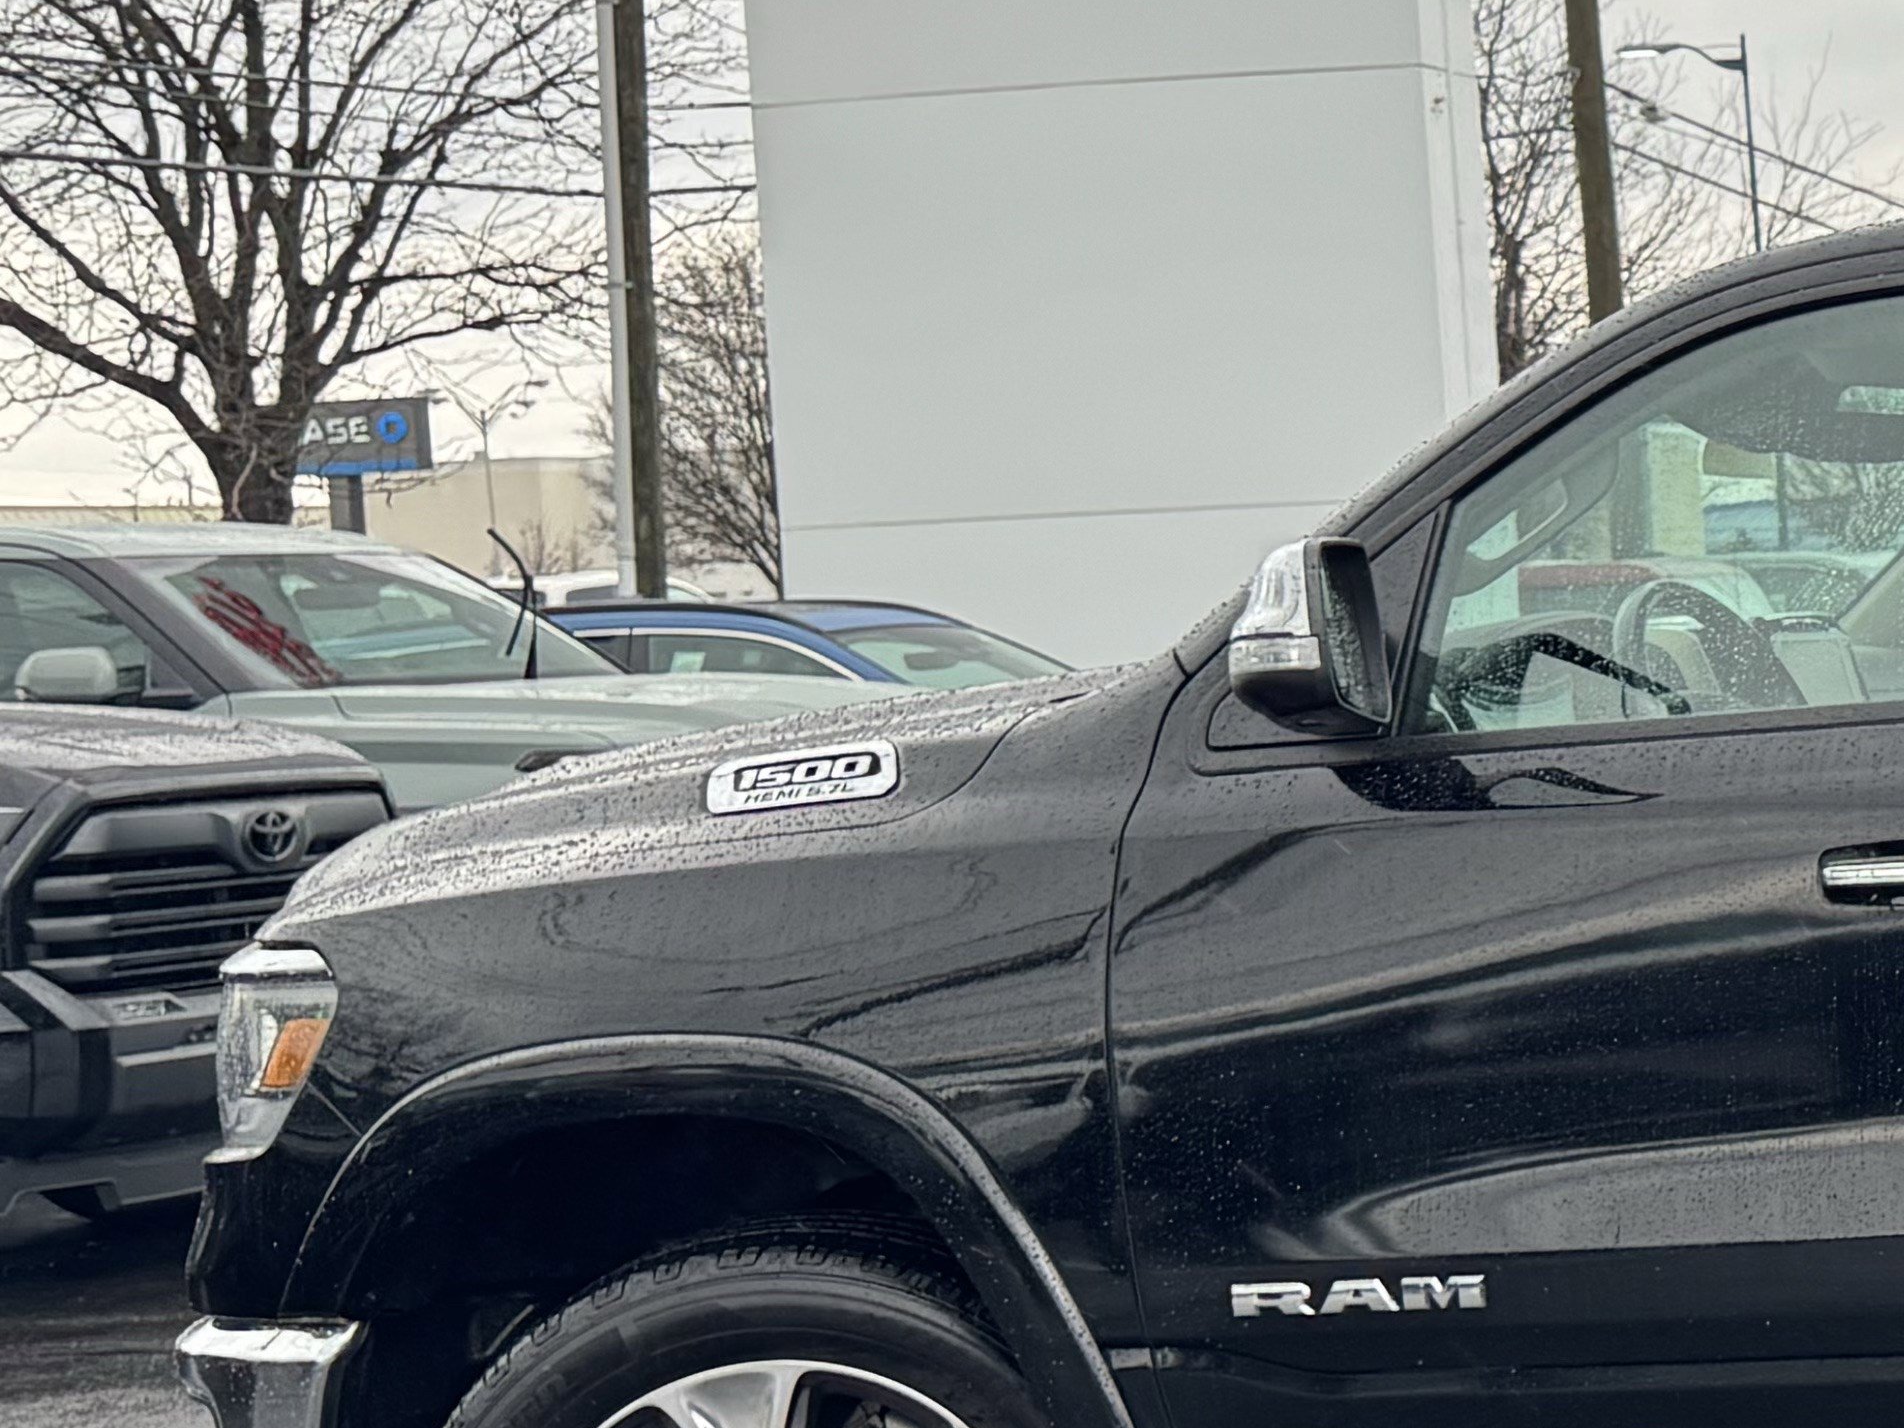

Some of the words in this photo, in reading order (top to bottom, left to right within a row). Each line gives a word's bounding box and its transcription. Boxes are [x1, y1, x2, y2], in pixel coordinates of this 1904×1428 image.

[299, 415, 371, 447] ASE
[738, 754, 873, 792] 1500
[744, 787, 800, 805] HEMI
[806, 782, 854, 798] 5.7L
[1231, 1274, 1487, 1317] RAM
